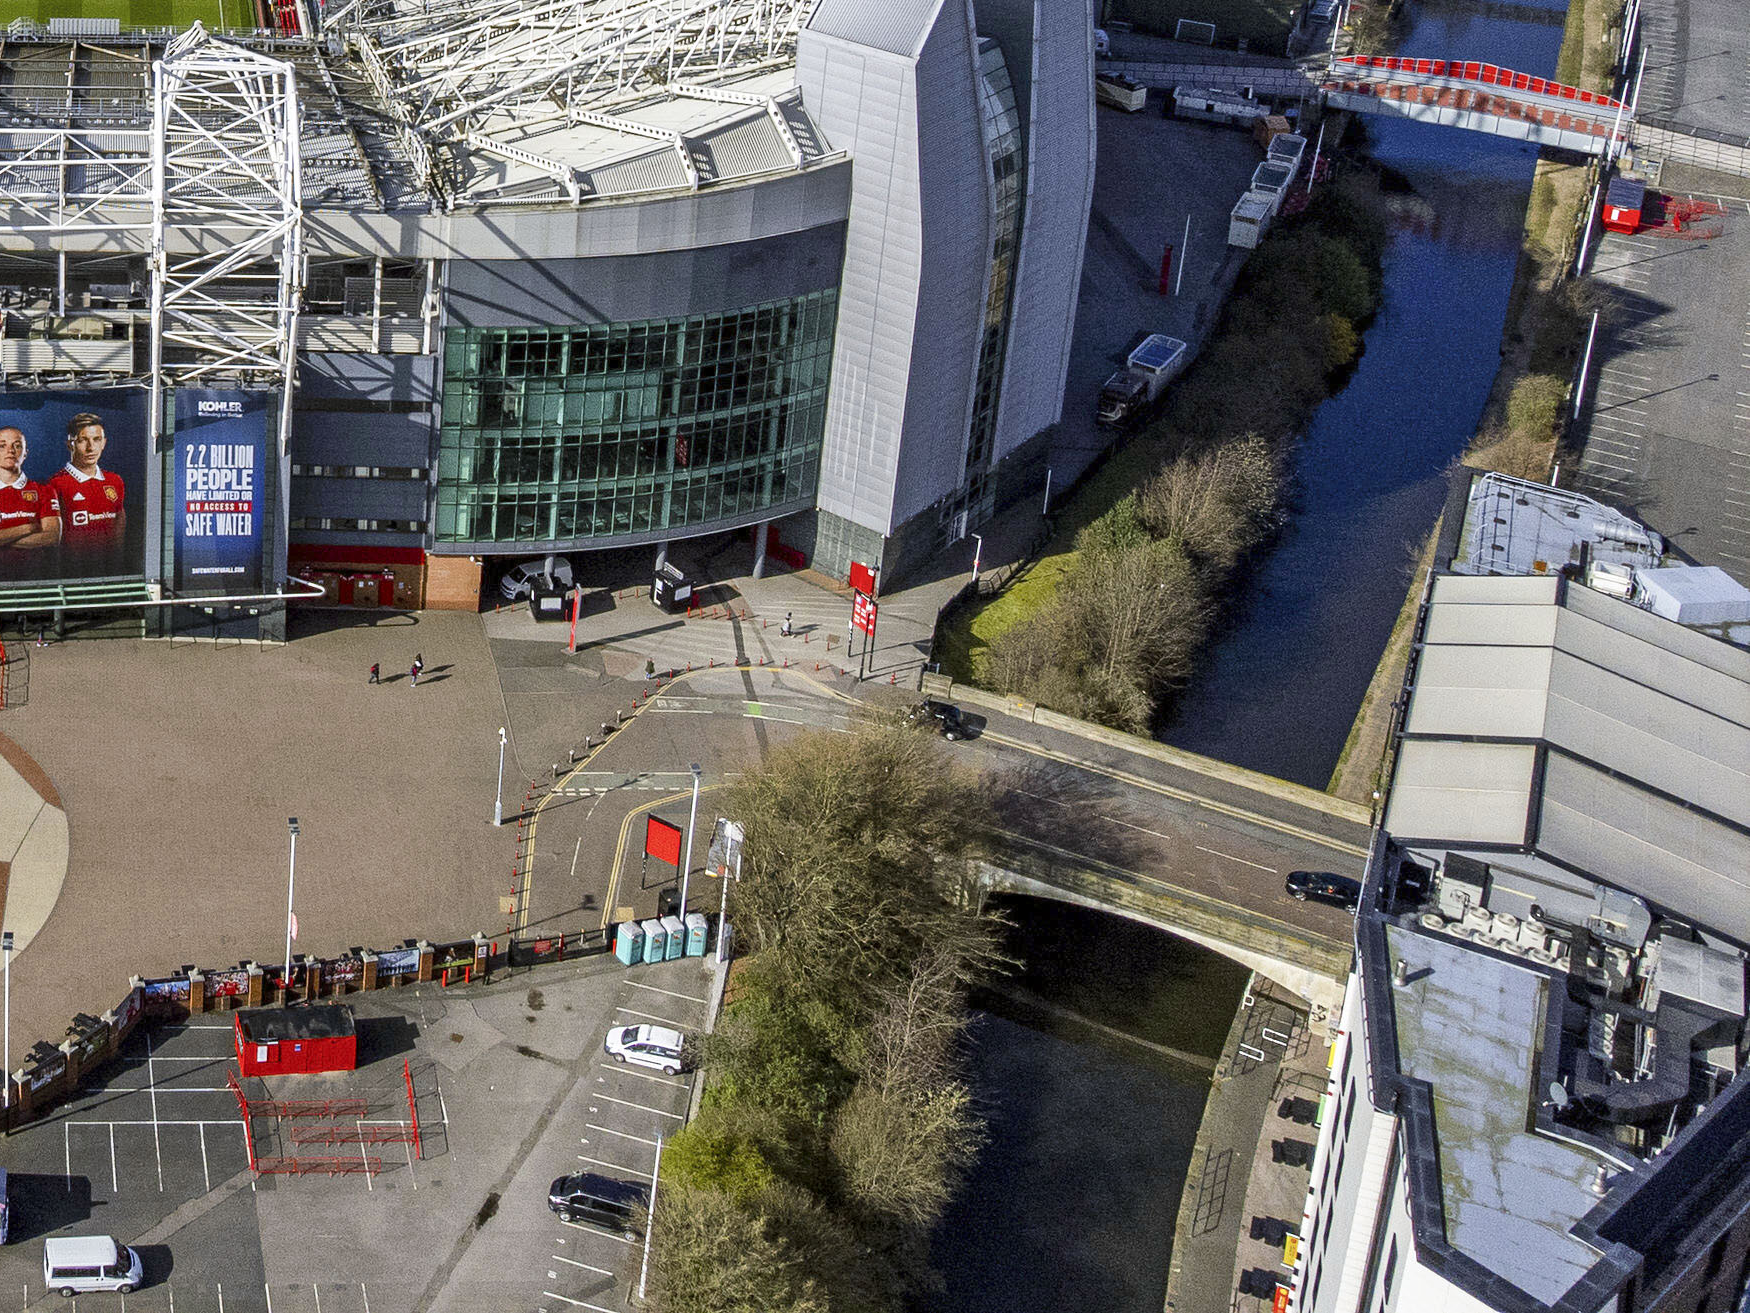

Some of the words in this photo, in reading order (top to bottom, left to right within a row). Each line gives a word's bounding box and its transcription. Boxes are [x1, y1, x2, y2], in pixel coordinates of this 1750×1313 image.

[198, 401, 243, 412] KOHLER
[186, 444, 206, 469] 2.2
[210, 445, 254, 469] BILLION
[186, 469, 253, 490] PEOPLE
[186, 491, 207, 501] HAVE
[208, 491, 240, 501] LIMITED
[241, 491, 253, 501] OR
[190, 503, 200, 511] NO
[204, 503, 235, 511] ACCESS
[238, 503, 249, 511] TO
[1, 510, 36, 519] TeamViewer
[186, 513, 213, 536] SAFE
[216, 514, 252, 536] WATER
